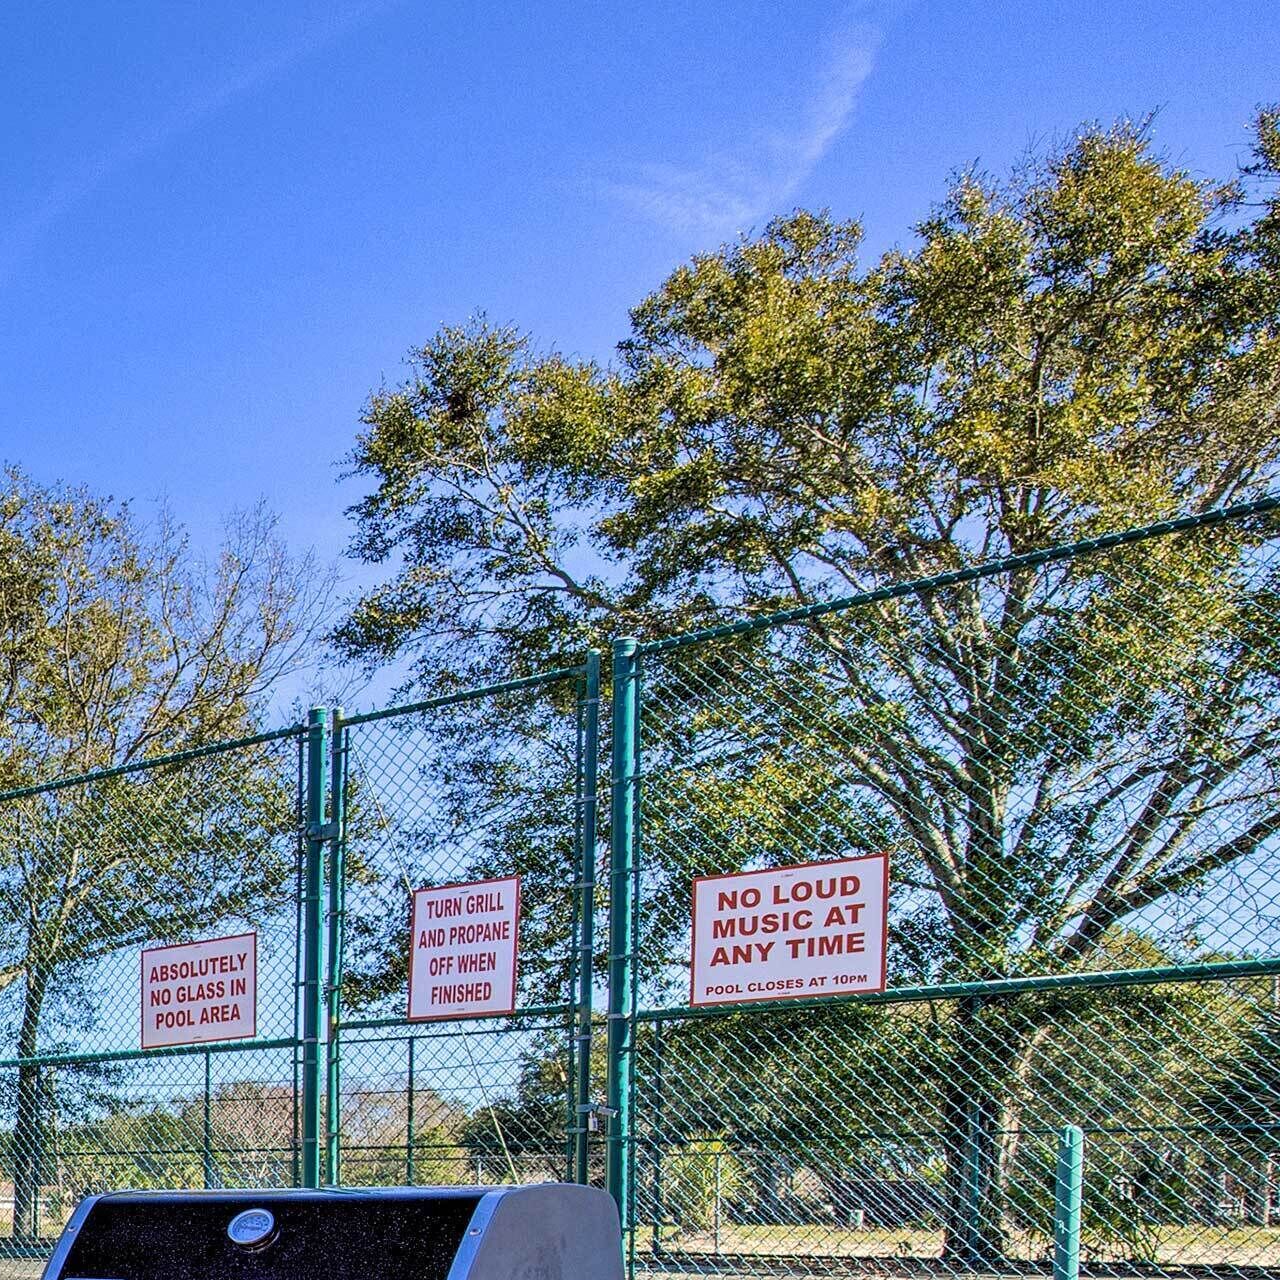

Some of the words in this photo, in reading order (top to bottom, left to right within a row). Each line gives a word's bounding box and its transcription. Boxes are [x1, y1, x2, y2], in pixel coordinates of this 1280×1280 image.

[427, 897, 462, 919] TURN
[466, 892, 504, 915] GRILL
[717, 888, 761, 912] NO
[773, 875, 861, 905] LOUD
[418, 928, 446, 949] AND
[449, 921, 510, 946] PROPANE
[712, 909, 813, 939] MUSIC
[823, 903, 866, 928] AT
[429, 956, 454, 976] OFF
[458, 951, 497, 974] WHEN
[710, 941, 775, 967] ANY
[785, 932, 865, 959] TIME
[149, 952, 248, 983] ABSOLUTELY
[150, 988, 171, 1007] NO
[176, 980, 225, 1003] GLASS
[230, 977, 246, 996] IN
[431, 982, 492, 1005] FINISHED
[705, 983, 743, 996] POOL
[747, 978, 804, 992] CLOSES
[808, 976, 828, 987] AT
[832, 974, 868, 985] 10PM
[156, 1009, 195, 1030] POOL
[200, 1003, 241, 1025] AREA
